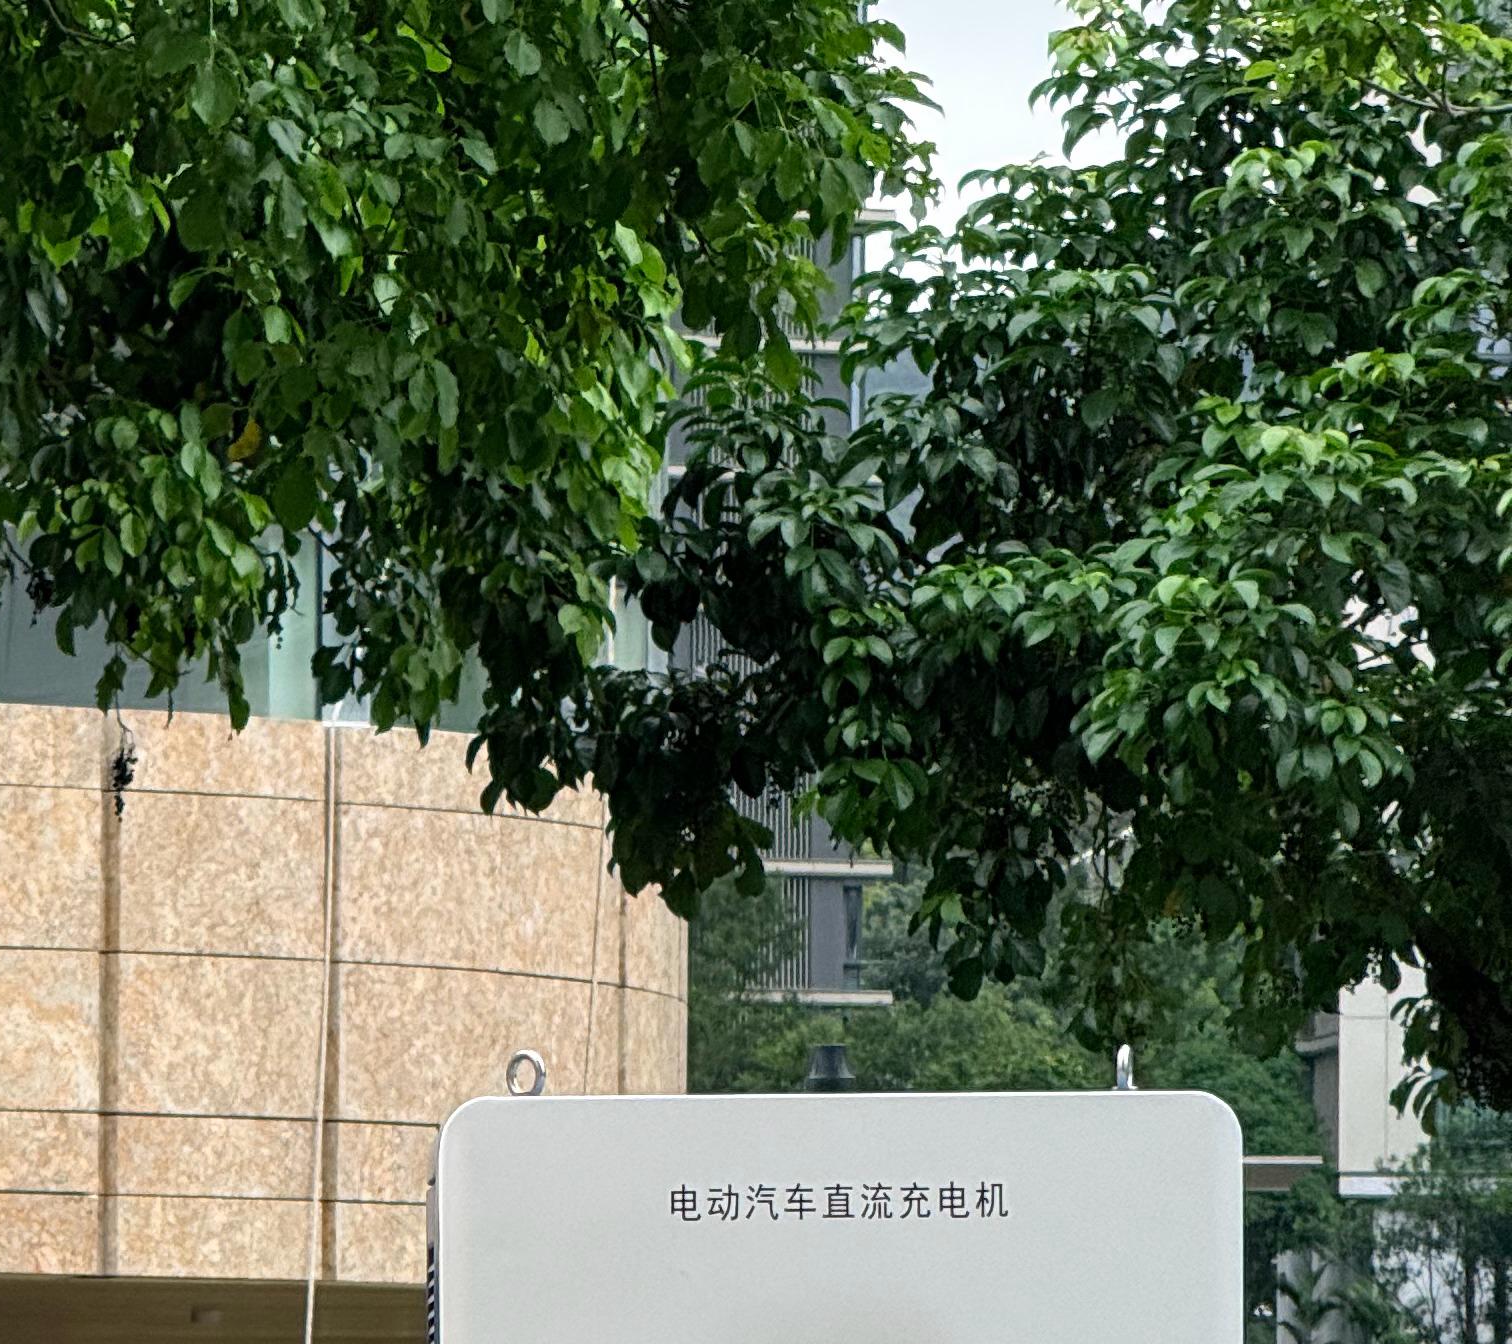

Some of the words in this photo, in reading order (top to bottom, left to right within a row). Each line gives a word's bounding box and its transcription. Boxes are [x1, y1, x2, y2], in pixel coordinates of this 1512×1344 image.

[670, 1181, 1009, 1222] 电动汽车直流充电机
